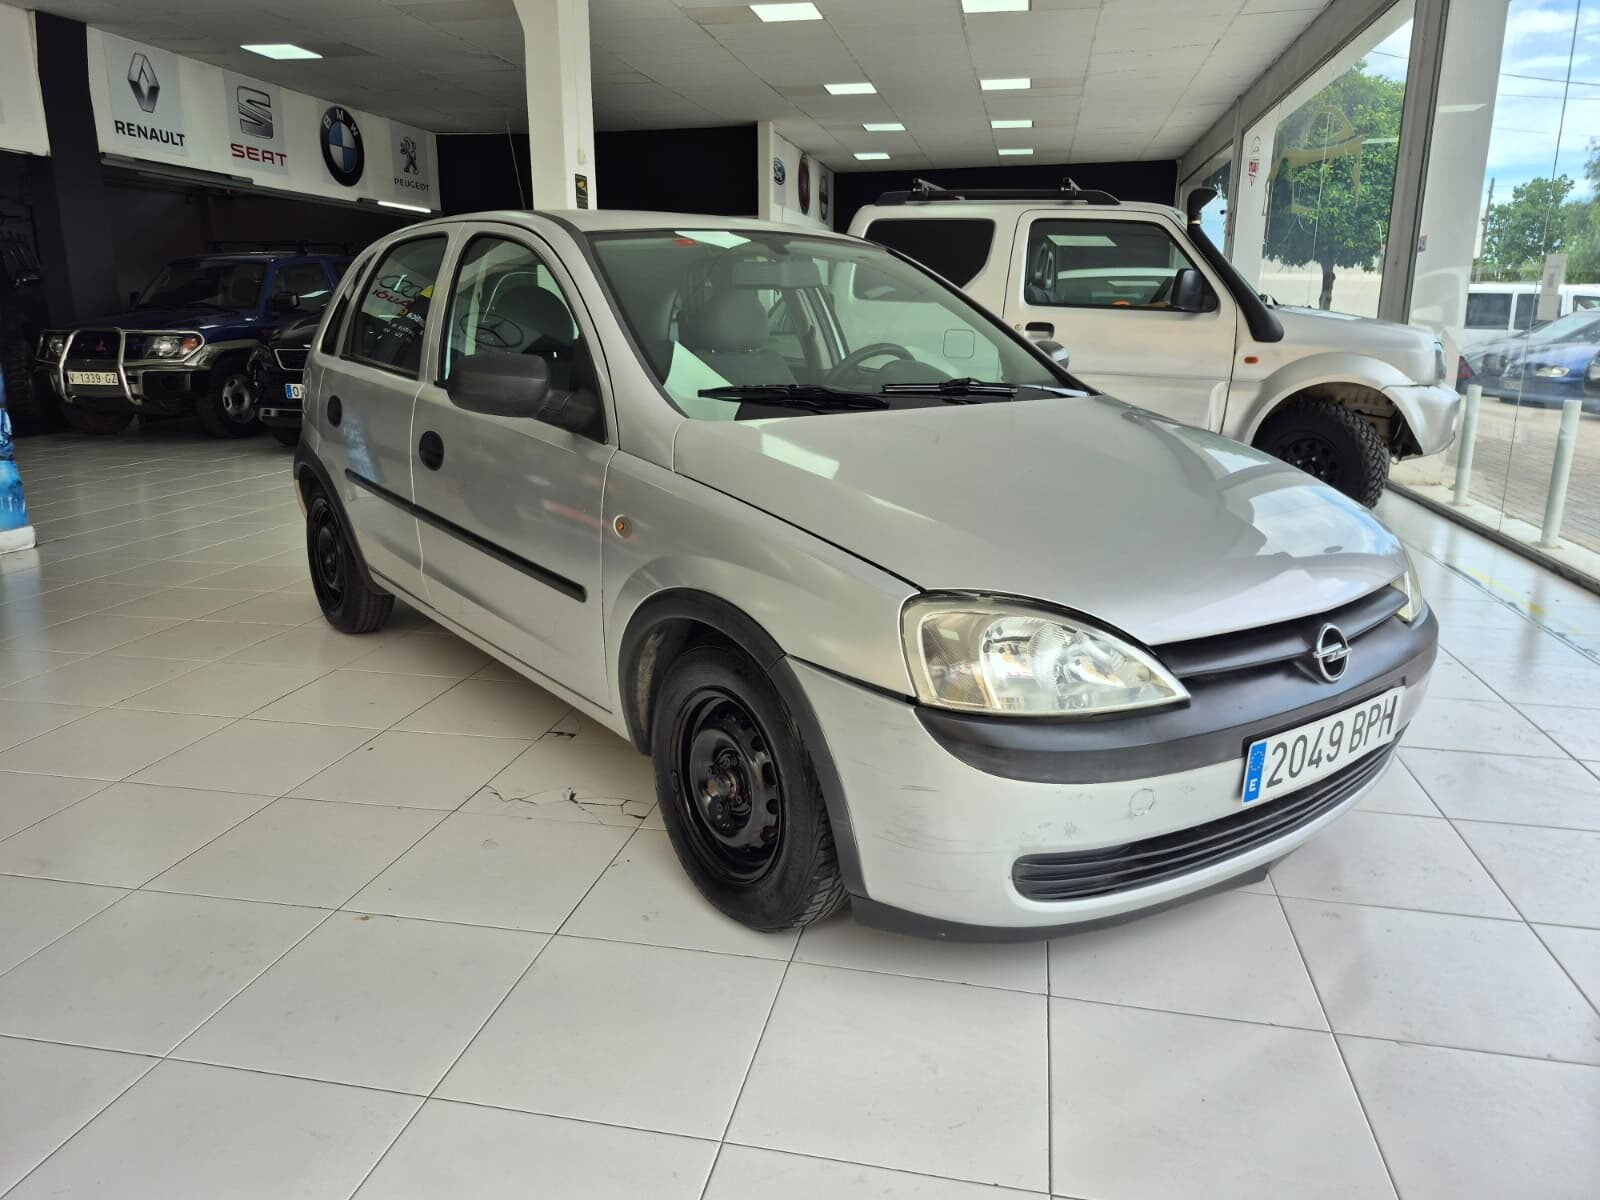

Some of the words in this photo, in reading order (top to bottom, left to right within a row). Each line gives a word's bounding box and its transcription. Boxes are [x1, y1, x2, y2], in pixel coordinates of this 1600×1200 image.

[114, 119, 186, 148] RENAULT
[230, 143, 287, 166] SEAT
[394, 177, 431, 192] PEUGEOT
[80, 373, 101, 384] 1339
[105, 373, 118, 384] GZ
[1266, 720, 1345, 788] 2049
[1348, 694, 1399, 754] BPH
[1248, 777, 1258, 792] E
